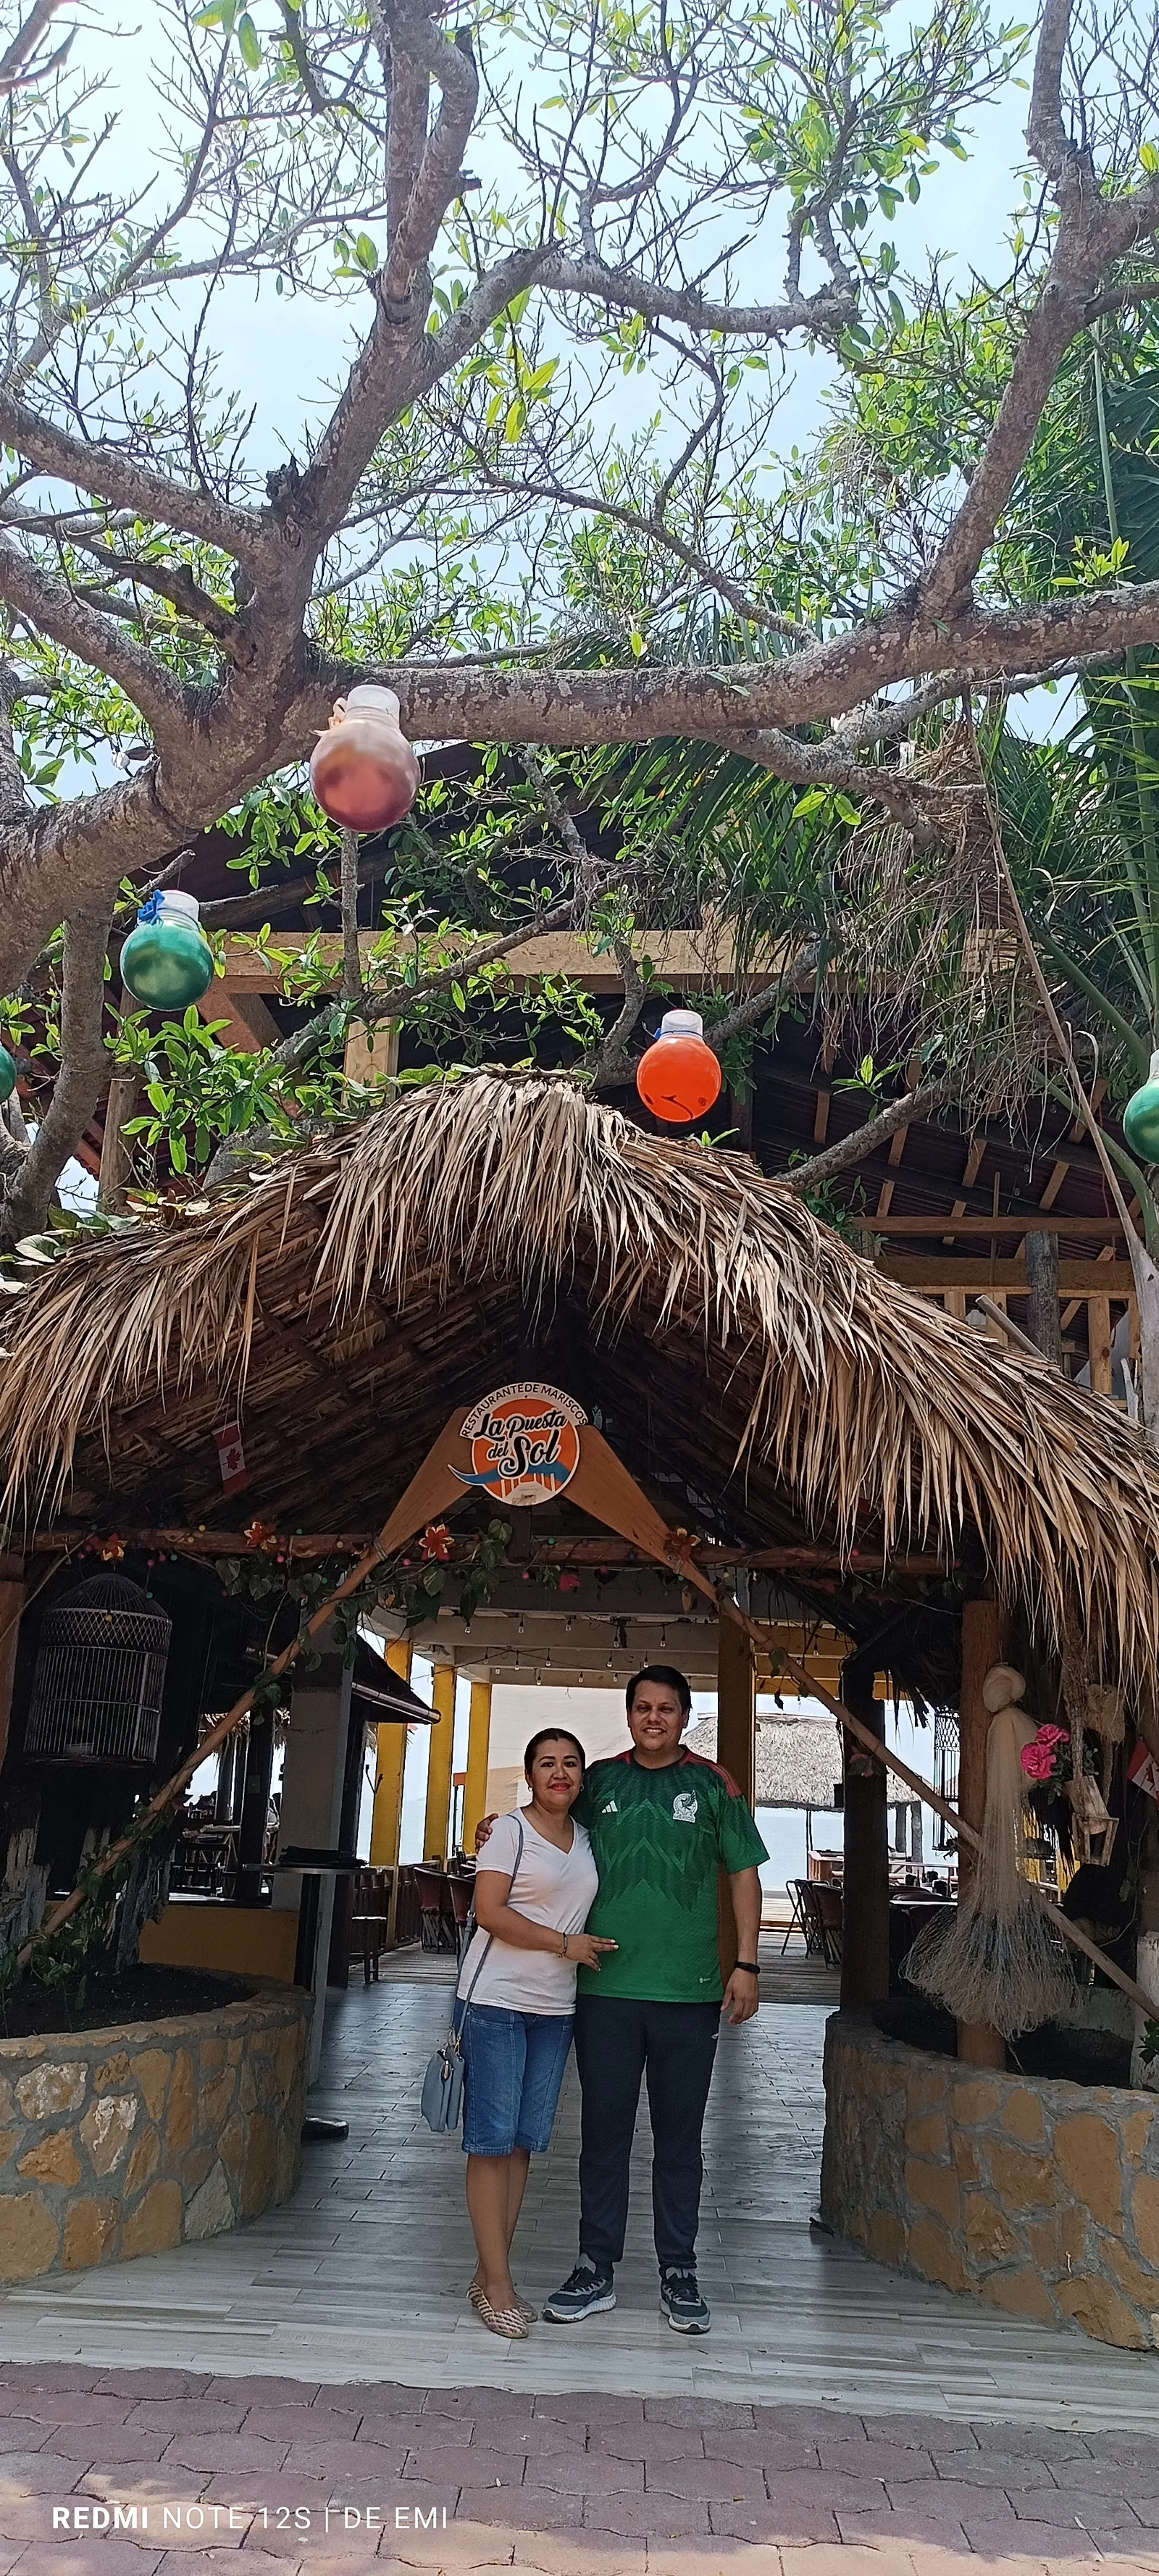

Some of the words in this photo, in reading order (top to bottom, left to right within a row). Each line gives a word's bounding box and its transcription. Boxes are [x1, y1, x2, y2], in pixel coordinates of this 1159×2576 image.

[473, 1413, 506, 1442] La
[507, 1410, 567, 1438] Puesta
[541, 1386, 587, 1426] MARISCOS
[488, 1442, 509, 1459] del
[499, 1430, 559, 1476] Sol
